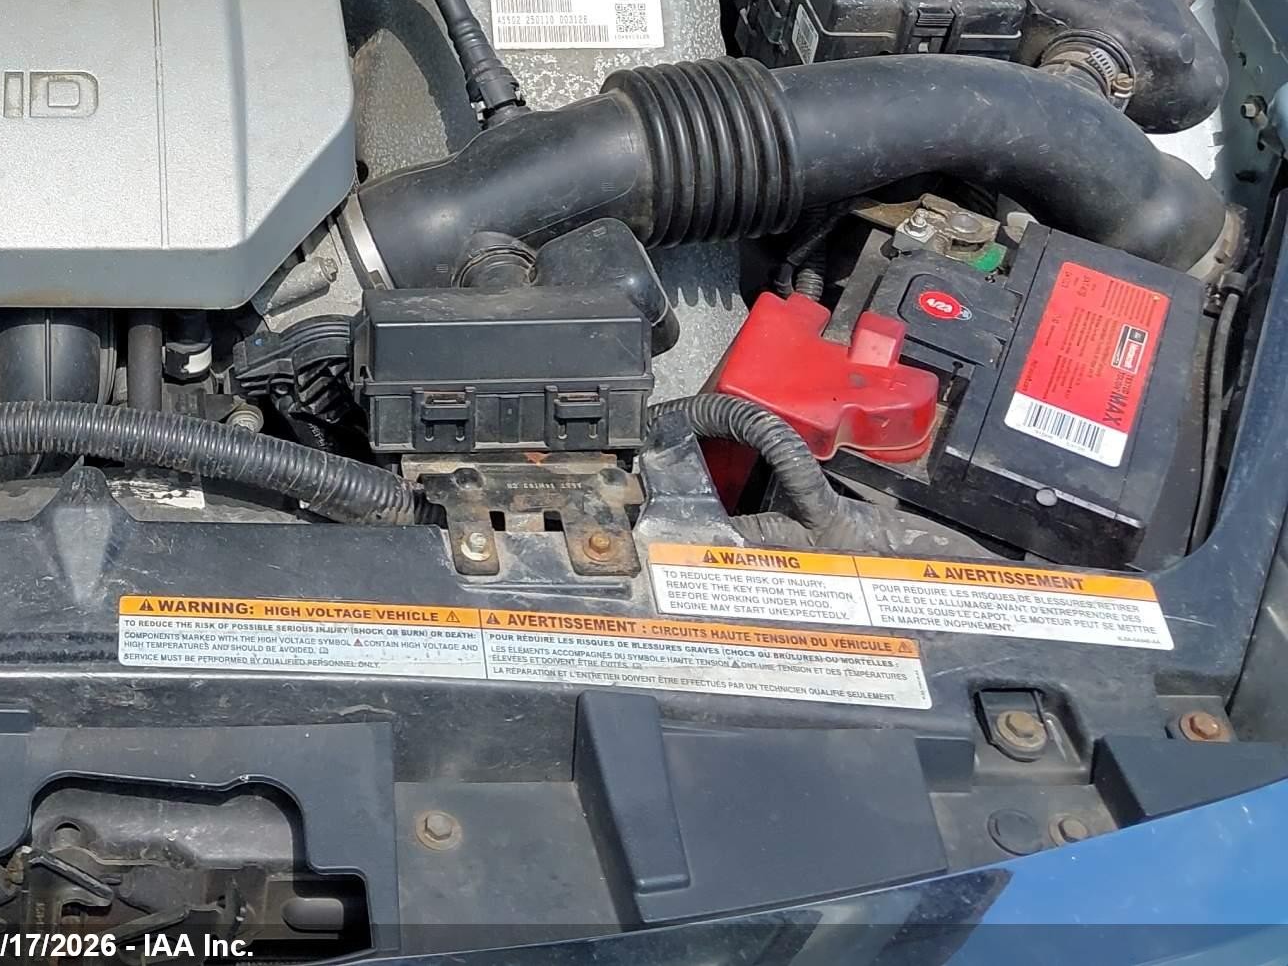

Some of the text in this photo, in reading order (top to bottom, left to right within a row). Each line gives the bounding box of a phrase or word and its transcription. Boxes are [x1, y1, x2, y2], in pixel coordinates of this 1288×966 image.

[1102, 391, 1130, 427] MAX
[719, 551, 801, 569] WARNING
[663, 569, 678, 579] TO
[679, 570, 721, 581] REDUCE
[723, 573, 743, 583] THE
[744, 575, 769, 584] RISK
[771, 576, 785, 586] OF
[942, 566, 1086, 590] AVERTISSEMENT
[665, 580, 854, 600] REMOVE THE KEY FROM THE IGNITION
[667, 590, 832, 608] BEFORE WORKING UNDER HOOD.
[871, 582, 901, 593] POUR
[948, 588, 969, 599] LES
[970, 590, 1016, 603] RISQUES
[1016, 593, 1032, 604] DE
[158, 599, 439, 622] WARNING: HIGH VOLTAGE VEHICLE
[669, 600, 708, 611] ENGINE
[709, 603, 731, 613] MAY
[733, 604, 765, 615] START
[874, 592, 889, 603] LA
[911, 595, 928, 606] DE
[993, 602, 1028, 614] AVANT
[1120, 612, 1142, 623] DES
[876, 603, 926, 616] TRAVAUX
[926, 607, 956, 618] SOUS
[956, 609, 972, 619] LE
[1013, 614, 1028, 624] LE
[1028, 615, 1072, 627] MOTEUR
[1072, 619, 1100, 630] PEUT
[1100, 621, 1115, 631] SE
[1116, 622, 1156, 634] METTRE
[879, 612, 895, 623] EN
[896, 614, 942, 627] MARCHE
[138, 619, 172, 627] REDUCE
[176, 620, 192, 628] THE
[194, 621, 215, 629] RISK
[217, 622, 227, 630] OF
[231, 623, 273, 631] POSSIBLE
[275, 624, 313, 633] SERIOUS
[315, 626, 348, 634] INJURY
[350, 627, 383, 635] (SHOCK
[385, 628, 398, 636] OR
[400, 629, 428, 637] BURN)
[430, 630, 442, 638] OR
[445, 631, 476, 639] DEATH:
[506, 613, 636, 634] AVERTISSEMENT
[650, 624, 707, 638] CIRCUITS
[709, 628, 750, 641] HAUTE
[754, 631, 807, 645] TENSION
[809, 635, 827, 647] DU
[124, 631, 478, 651] COMPONENTS MARKED WITH THE HIGH VOLTAGE SYMBOL CONTAIN HIGH VOLTAGE AND
[124, 640, 143, 648] HIGH
[146, 640, 209, 650] TEMPERATURES
[212, 643, 228, 651] AND
[230, 643, 263, 652] SHOULD
[265, 645, 276, 653] BE
[489, 631, 514, 641] POUR
[557, 636, 574, 645] LES
[575, 637, 615, 648] RISQUES
[617, 640, 629, 649] DE
[631, 641, 682, 653] BLESSURES
[684, 645, 720, 656] GRAVES
[123, 652, 158, 661] SERVICE
[160, 653, 182, 662] MUST
[184, 654, 195, 662] BE
[197, 655, 247, 664] PERFORMED
[250, 656, 260, 665] BY
[262, 657, 306, 666] QUALIFIED
[307, 659, 355, 668] PERSONNEL
[490, 643, 505, 652] LES
[613, 652, 626, 661] DU
[626, 653, 665, 663] SYMBOLE
[666, 655, 694, 665] HAUTE
[695, 657, 729, 668] TENSION
[776, 663, 812, 674] TENSION
[812, 666, 824, 674] ET
[824, 666, 841, 676] DES
[529, 655, 540, 664] ET
[540, 656, 576, 666] DOIVENT
[492, 664, 504, 674] LA
[556, 668, 568, 678] ET
[621, 673, 656, 684] DOIVENT
[727, 680, 745, 690] PAR
[745, 682, 757, 691] UN
[759, 682, 806, 695] TECHNICIEN
